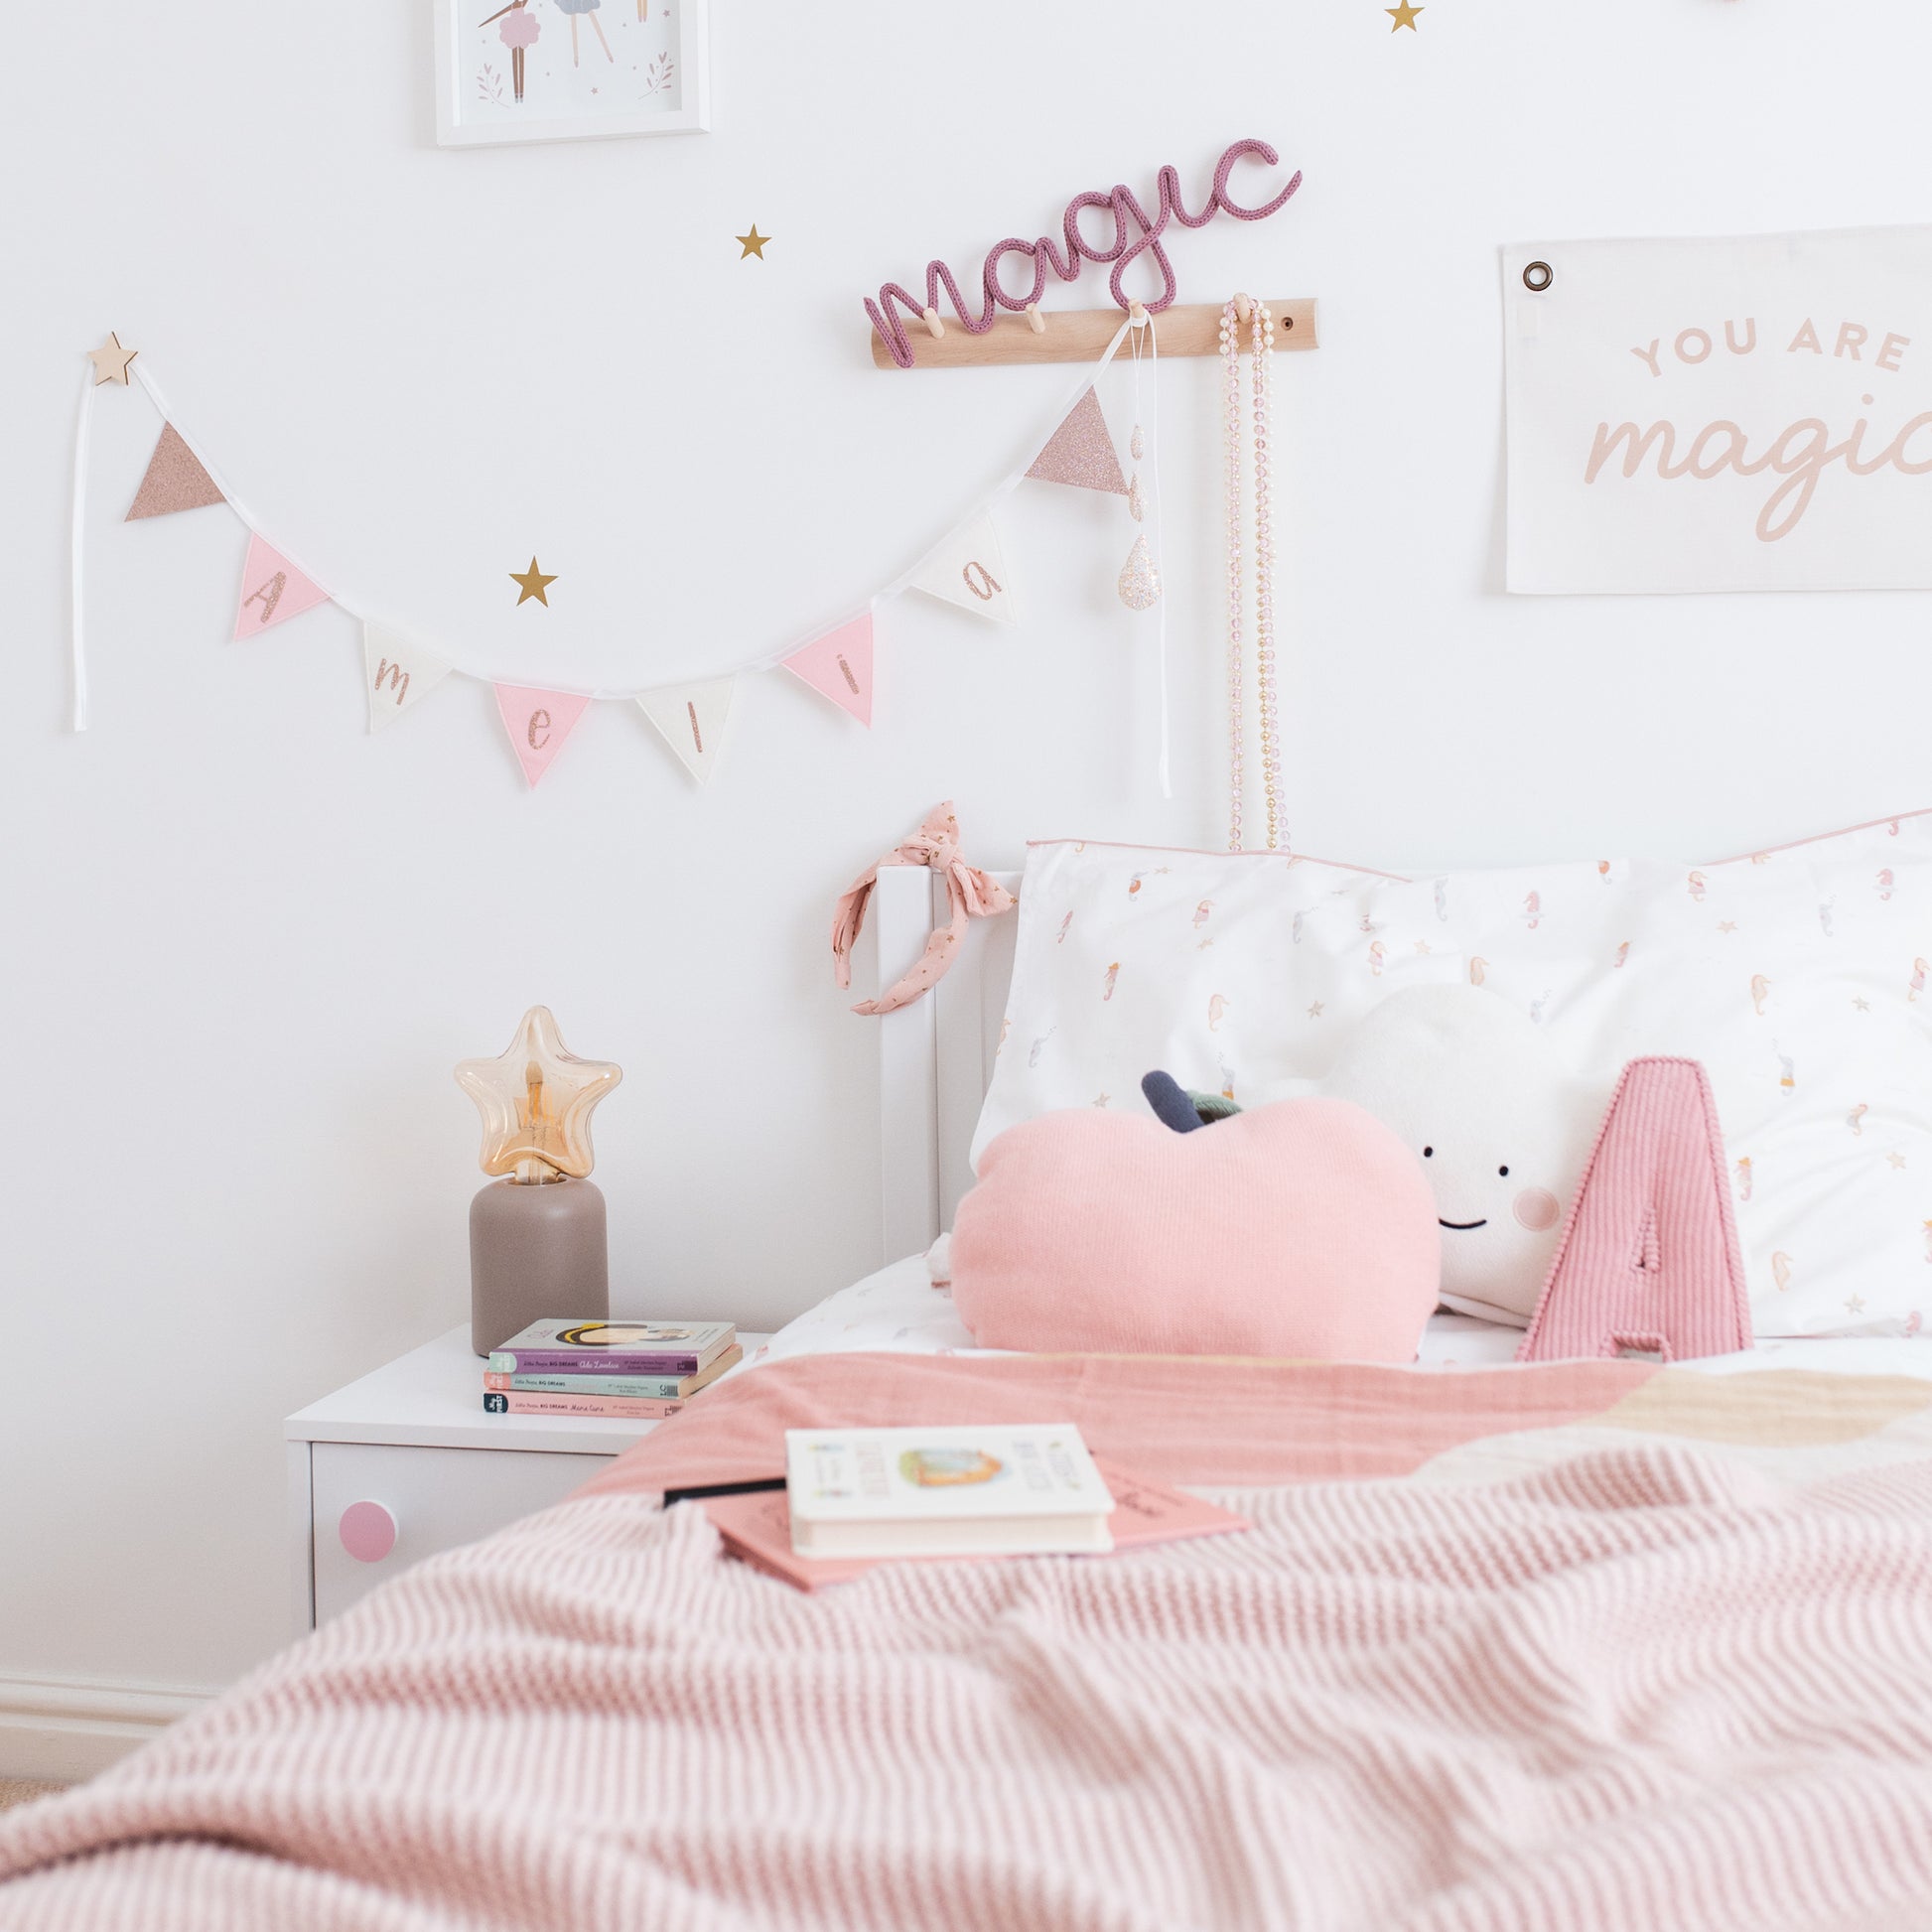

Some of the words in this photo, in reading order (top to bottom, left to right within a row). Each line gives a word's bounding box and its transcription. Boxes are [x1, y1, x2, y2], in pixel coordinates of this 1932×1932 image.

[863, 138, 1303, 368] magic
[1630, 318, 1757, 377] YOU
[1787, 318, 1911, 372] ARE
[1514, 1055, 1755, 1362] A
